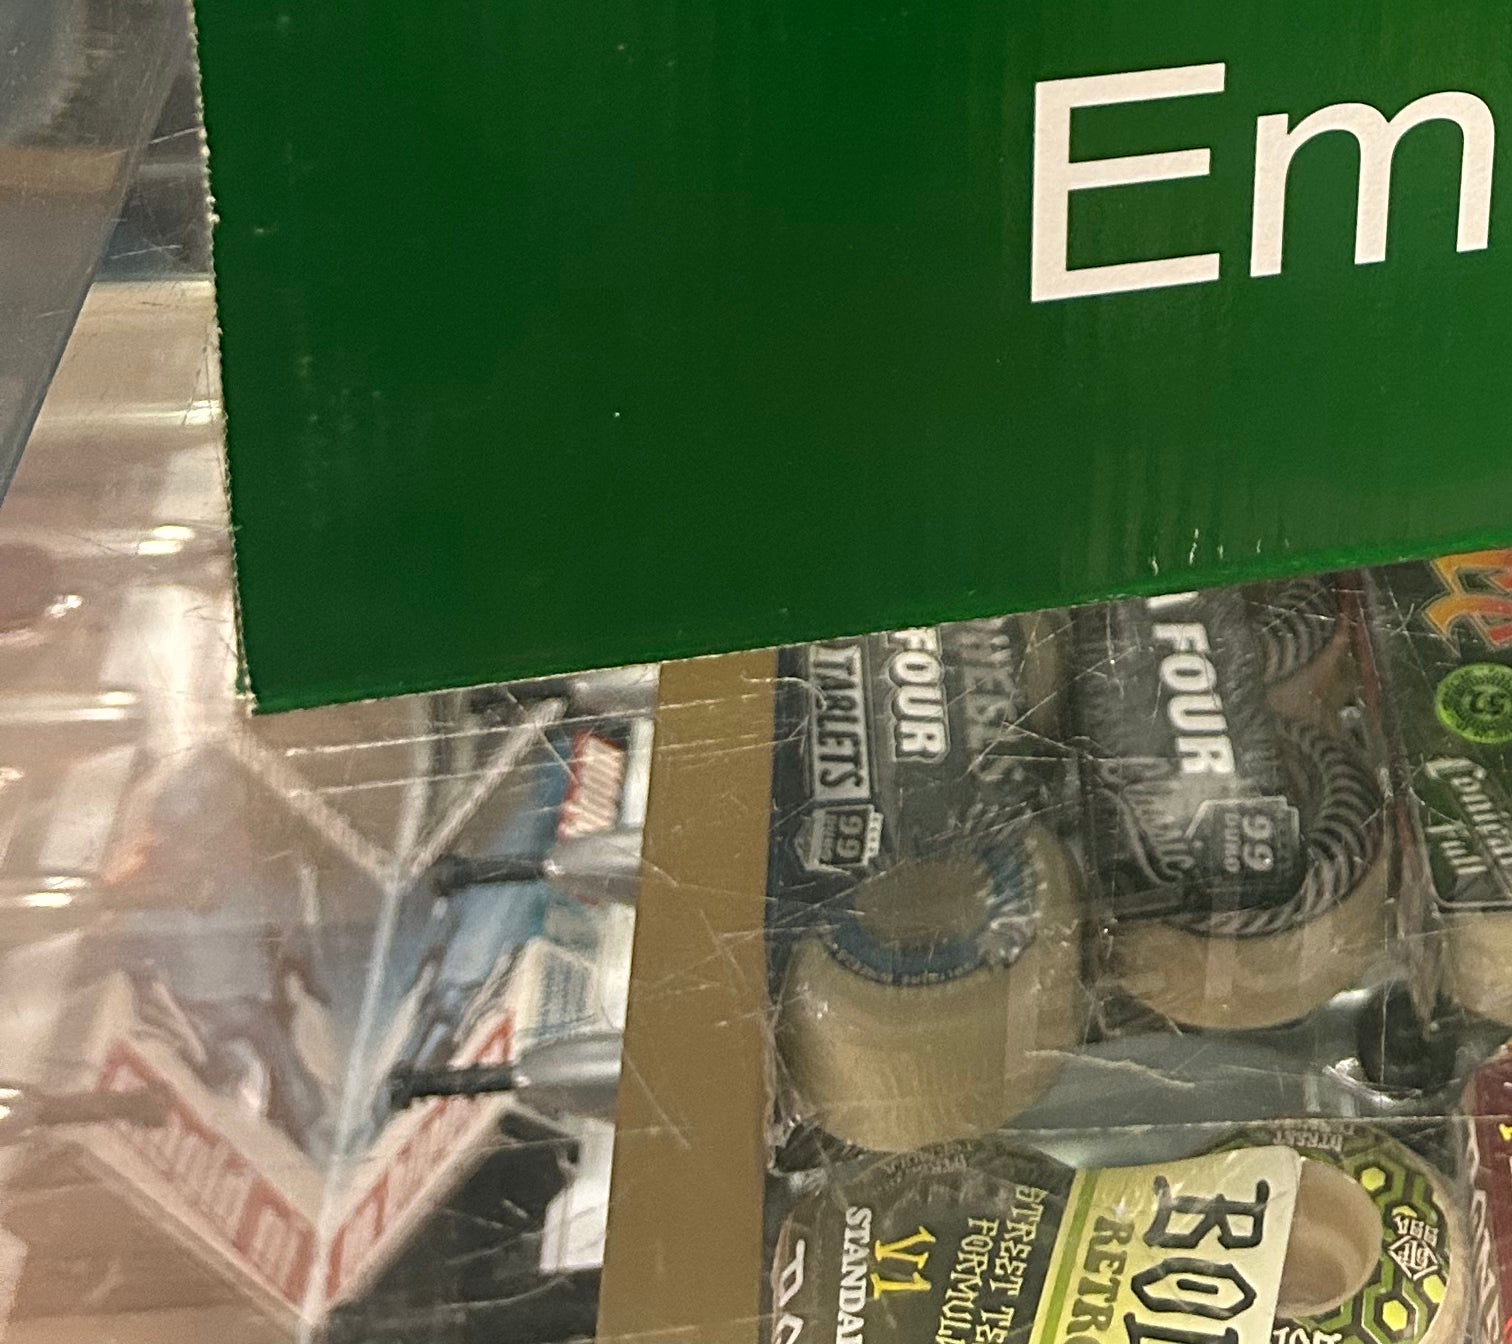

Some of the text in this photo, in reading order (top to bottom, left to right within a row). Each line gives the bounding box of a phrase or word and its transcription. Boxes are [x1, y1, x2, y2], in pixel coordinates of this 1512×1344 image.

[812, 656, 865, 790] TABLETS
[889, 628, 948, 763] FOUR
[1150, 622, 1237, 775] FOUR
[834, 813, 865, 860] 99
[1241, 813, 1276, 872] 99
[870, 1225, 937, 1300] V1
[973, 1184, 1049, 1344] STREET TE
